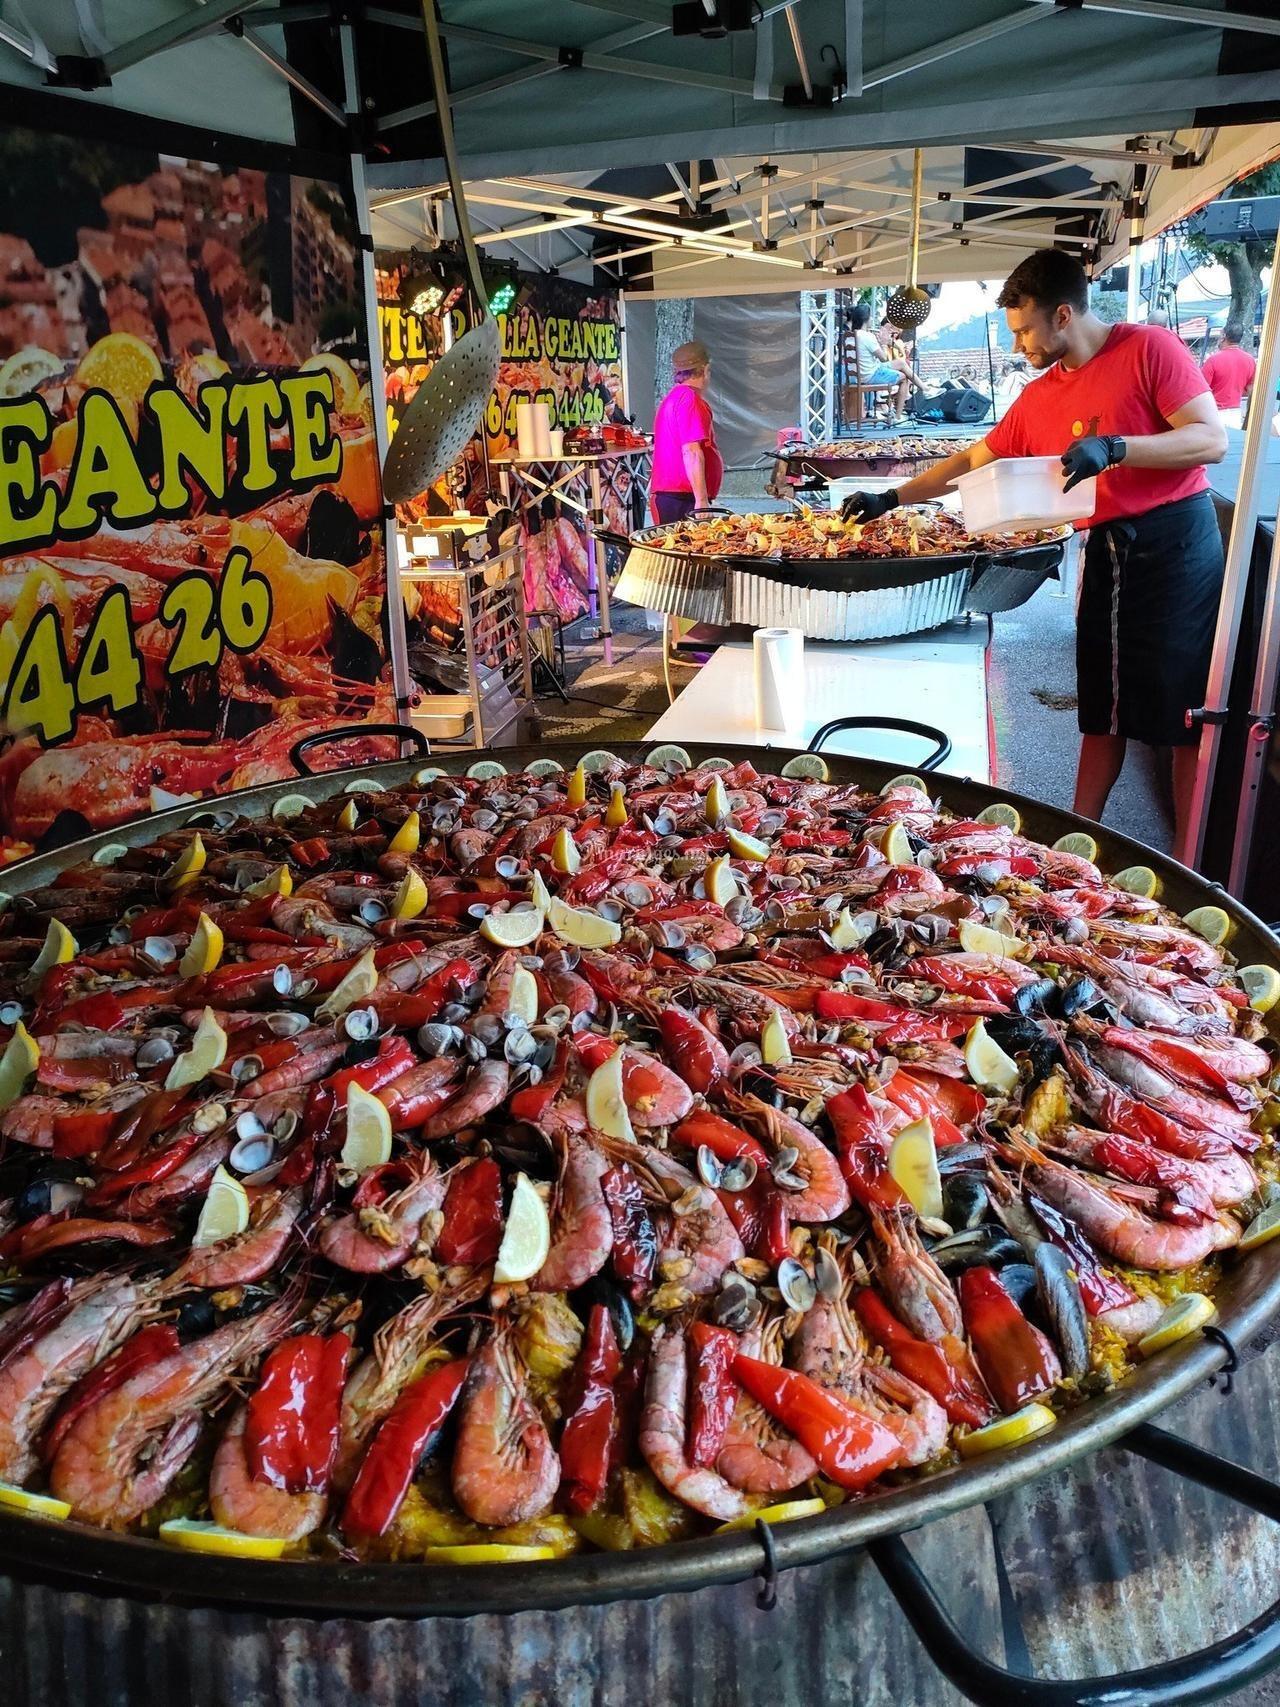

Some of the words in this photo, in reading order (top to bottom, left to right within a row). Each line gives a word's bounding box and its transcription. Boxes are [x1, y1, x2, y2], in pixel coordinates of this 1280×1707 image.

[377, 306, 428, 361] TE
[544, 316, 618, 360] GEANTE
[504, 393, 530, 436] 4
[559, 389, 580, 428] 44
[583, 387, 604, 422] 26
[0, 373, 343, 546] EANTE
[6, 591, 140, 743] 44
[162, 552, 271, 675] 26
